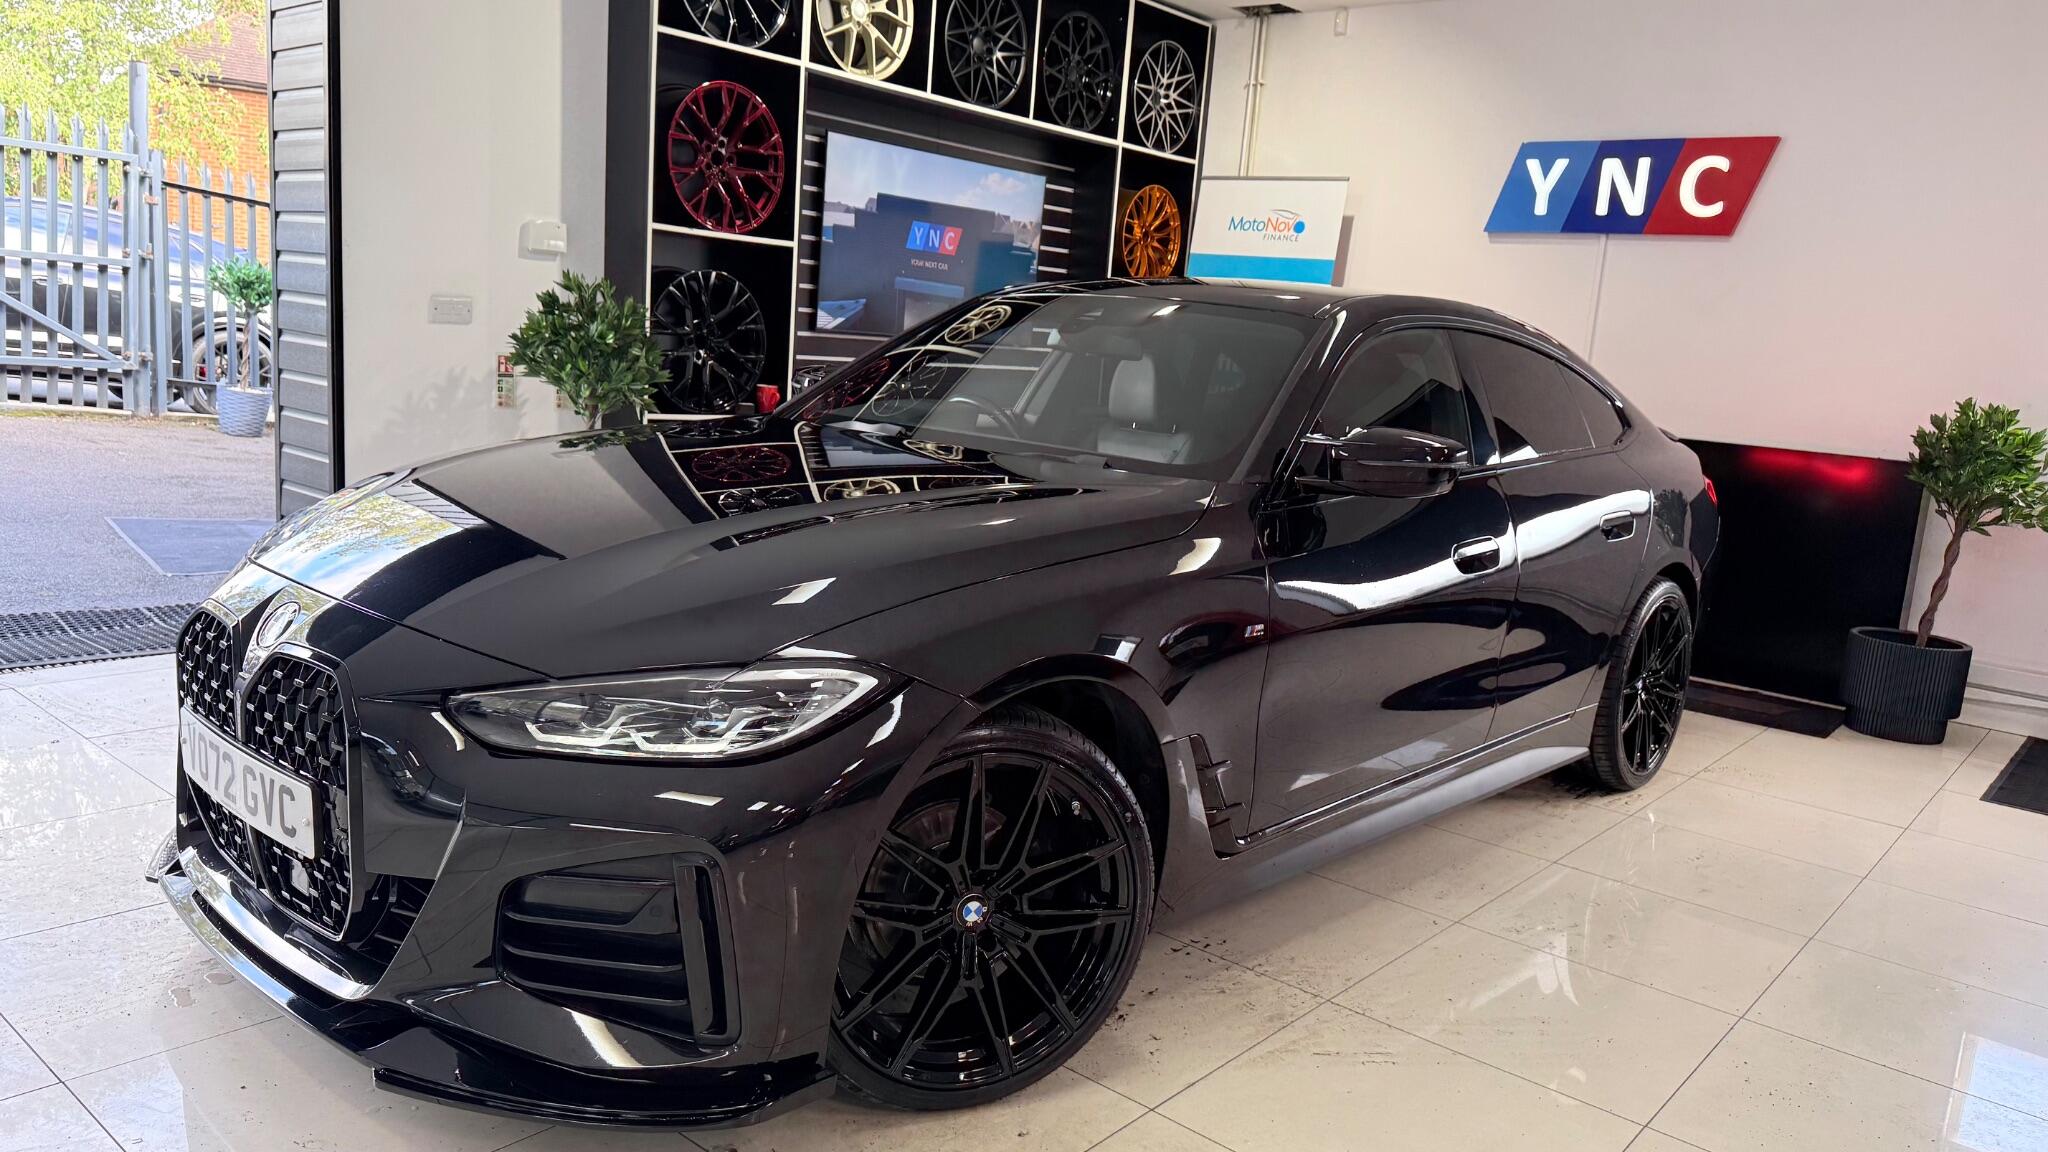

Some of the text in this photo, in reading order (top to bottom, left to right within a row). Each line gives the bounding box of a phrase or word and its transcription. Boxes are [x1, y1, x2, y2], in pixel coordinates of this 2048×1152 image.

[1525, 155, 1731, 218] YNC
[914, 226, 955, 250] YNC
[1262, 233, 1300, 243] FINANCE
[925, 261, 937, 269] NEXT
[243, 764, 297, 839] GVC
